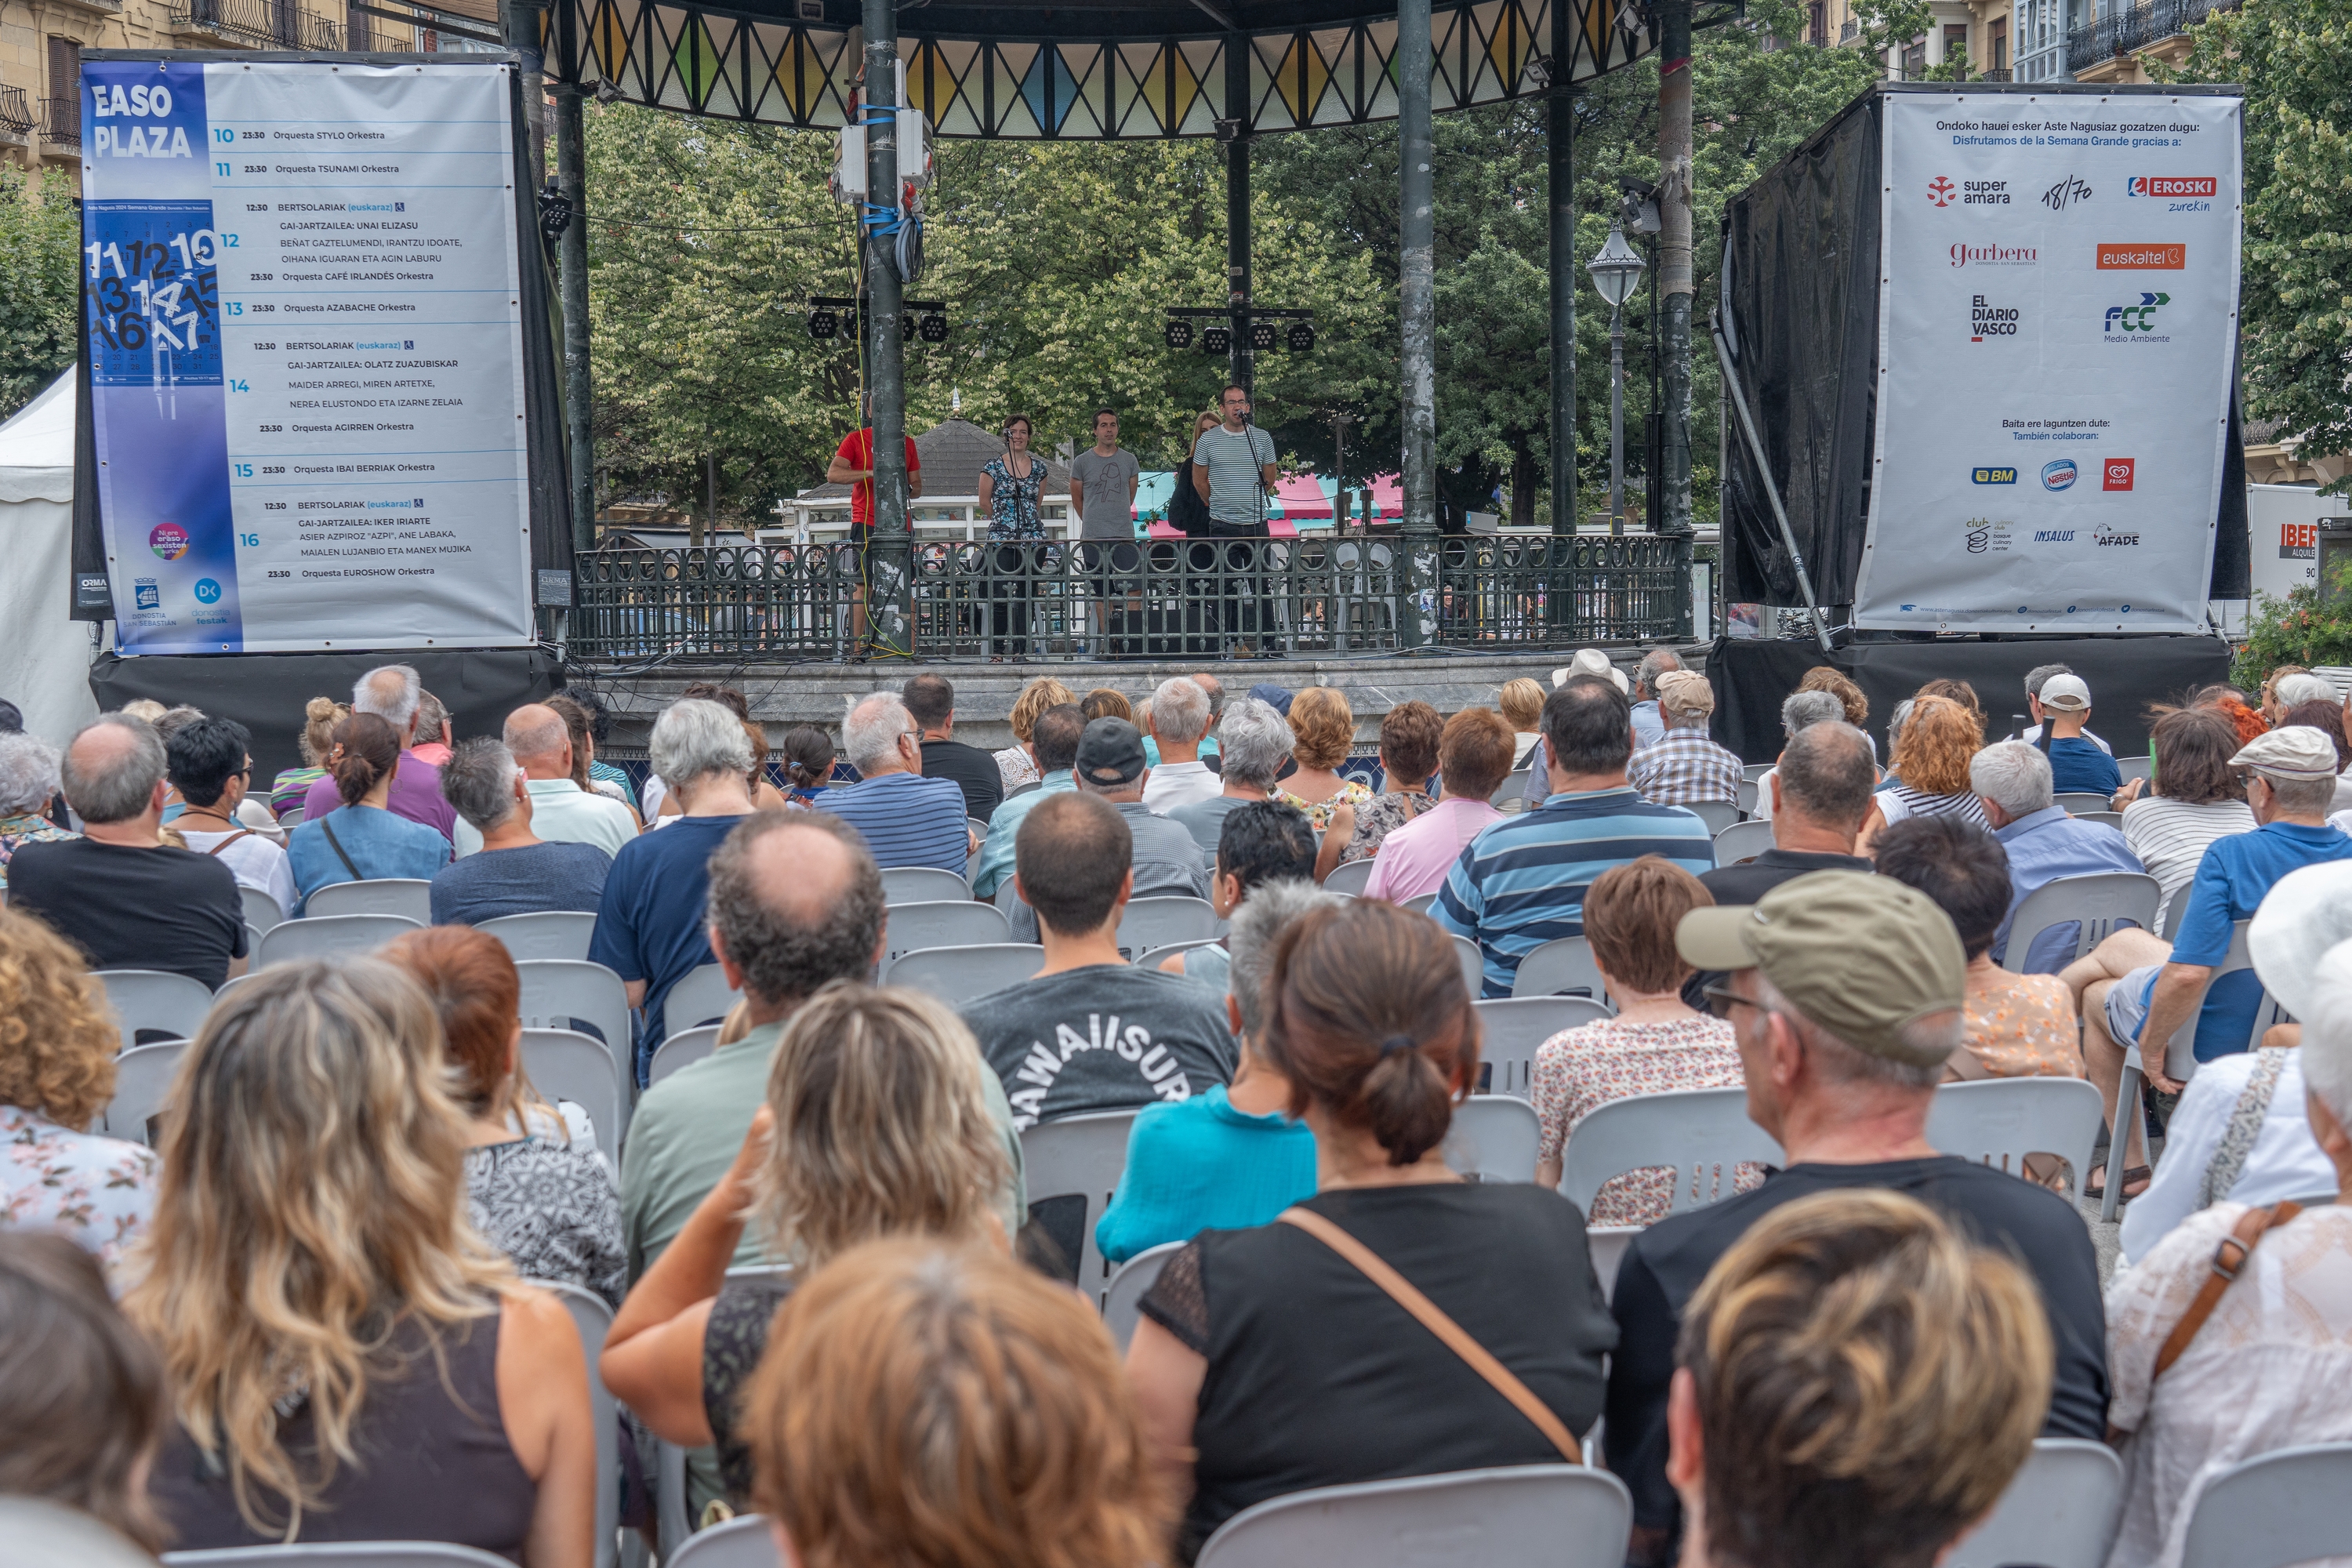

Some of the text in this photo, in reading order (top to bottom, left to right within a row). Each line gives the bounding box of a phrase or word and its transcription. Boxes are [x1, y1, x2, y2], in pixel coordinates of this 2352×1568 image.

[92, 85, 172, 117] EASO
[1936, 121, 2199, 133] Ondoko hauei esker Aste Nagusiaz gozatzen dugu:
[95, 126, 192, 158] PLAZA
[214, 129, 234, 143] 10
[274, 132, 314, 140] Orquesta
[1953, 136, 2016, 145] Disfrutamos
[2020, 136, 2032, 144] de
[2036, 136, 2044, 145] la
[2048, 136, 2088, 145] Semana
[2092, 136, 2129, 146] Grande
[2132, 139, 2169, 147] gracias
[216, 163, 230, 176] 11
[276, 165, 315, 174] Orquesta
[1963, 180, 2007, 194] super
[2154, 181, 2211, 193] EROSKI
[1963, 192, 2010, 204] amara
[348, 204, 393, 212] (euskaraz)
[2169, 201, 2209, 212] zurekin
[221, 234, 239, 247] 12
[281, 238, 310, 247] BEÑAT
[85, 229, 216, 280] 11 12 10
[1950, 243, 2038, 268] garbera
[2103, 251, 2165, 264] euskaltel
[325, 271, 348, 280] CAFÉ
[350, 271, 394, 280] IRLANDÉS
[87, 270, 220, 318] 13 14 15
[1973, 296, 1988, 307] EL
[225, 303, 243, 315] 13
[1973, 309, 2019, 321] DIARIO
[2105, 307, 2156, 332] FCC
[91, 310, 199, 351] 16 17
[1972, 323, 2016, 335] VASCO
[357, 342, 401, 350] (euskaraz)
[230, 379, 249, 392] 14
[2044, 419, 2086, 429] laguntzen
[235, 464, 252, 477] 15
[1991, 470, 2014, 482] BM
[2048, 470, 2074, 485] Nestlé
[368, 500, 411, 509] (euskaraz)
[240, 534, 259, 546] 16
[2034, 531, 2074, 541] INSALUS
[2098, 535, 2140, 546] AFADE
